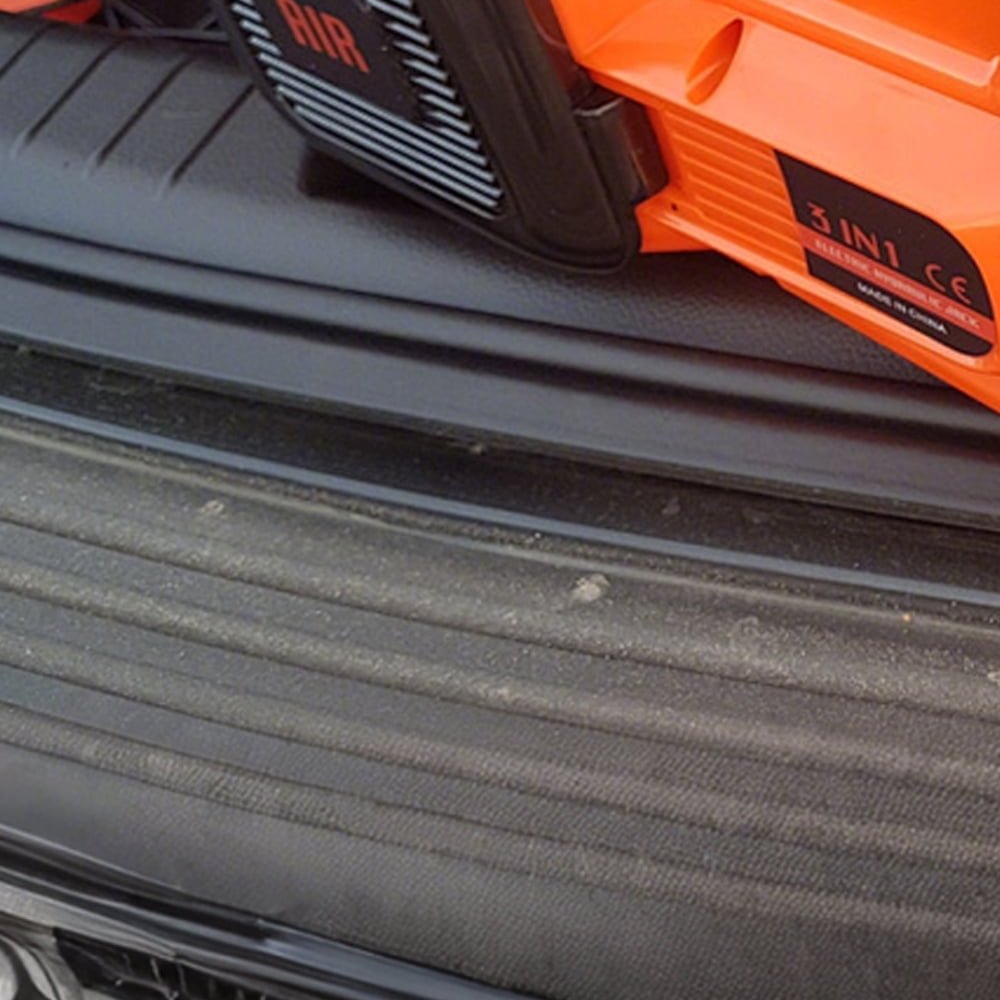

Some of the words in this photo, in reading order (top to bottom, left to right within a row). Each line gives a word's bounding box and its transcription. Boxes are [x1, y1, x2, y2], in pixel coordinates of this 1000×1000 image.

[807, 202, 831, 234] 3
[857, 282, 891, 307] MADE
[893, 301, 906, 313] IN
